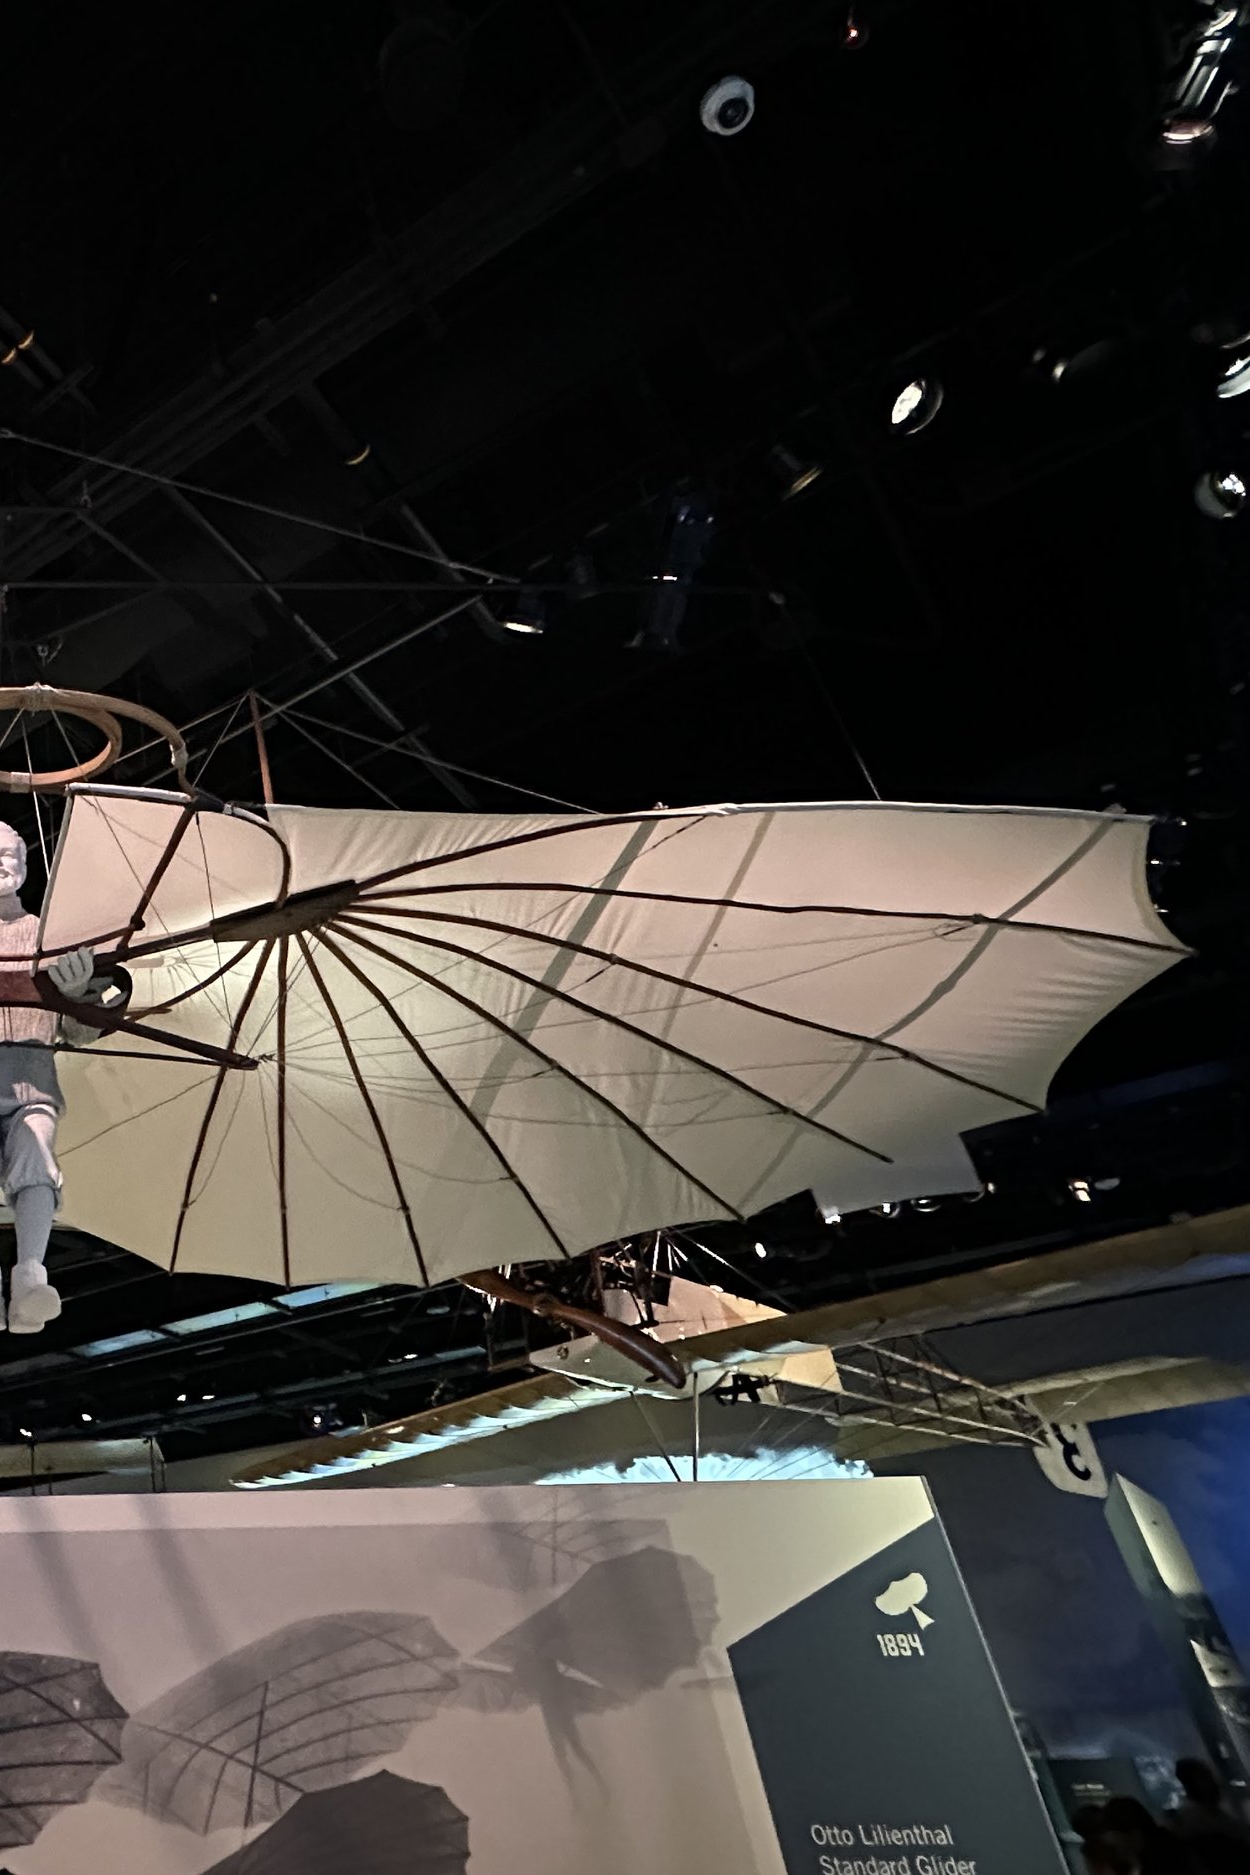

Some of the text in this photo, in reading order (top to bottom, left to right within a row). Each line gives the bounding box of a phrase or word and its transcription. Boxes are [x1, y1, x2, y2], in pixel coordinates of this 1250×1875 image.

[877, 1633, 924, 1656] 1894
[811, 1824, 954, 1846] Otto Lilienthal
[819, 1855, 976, 1875] Standard Glider
